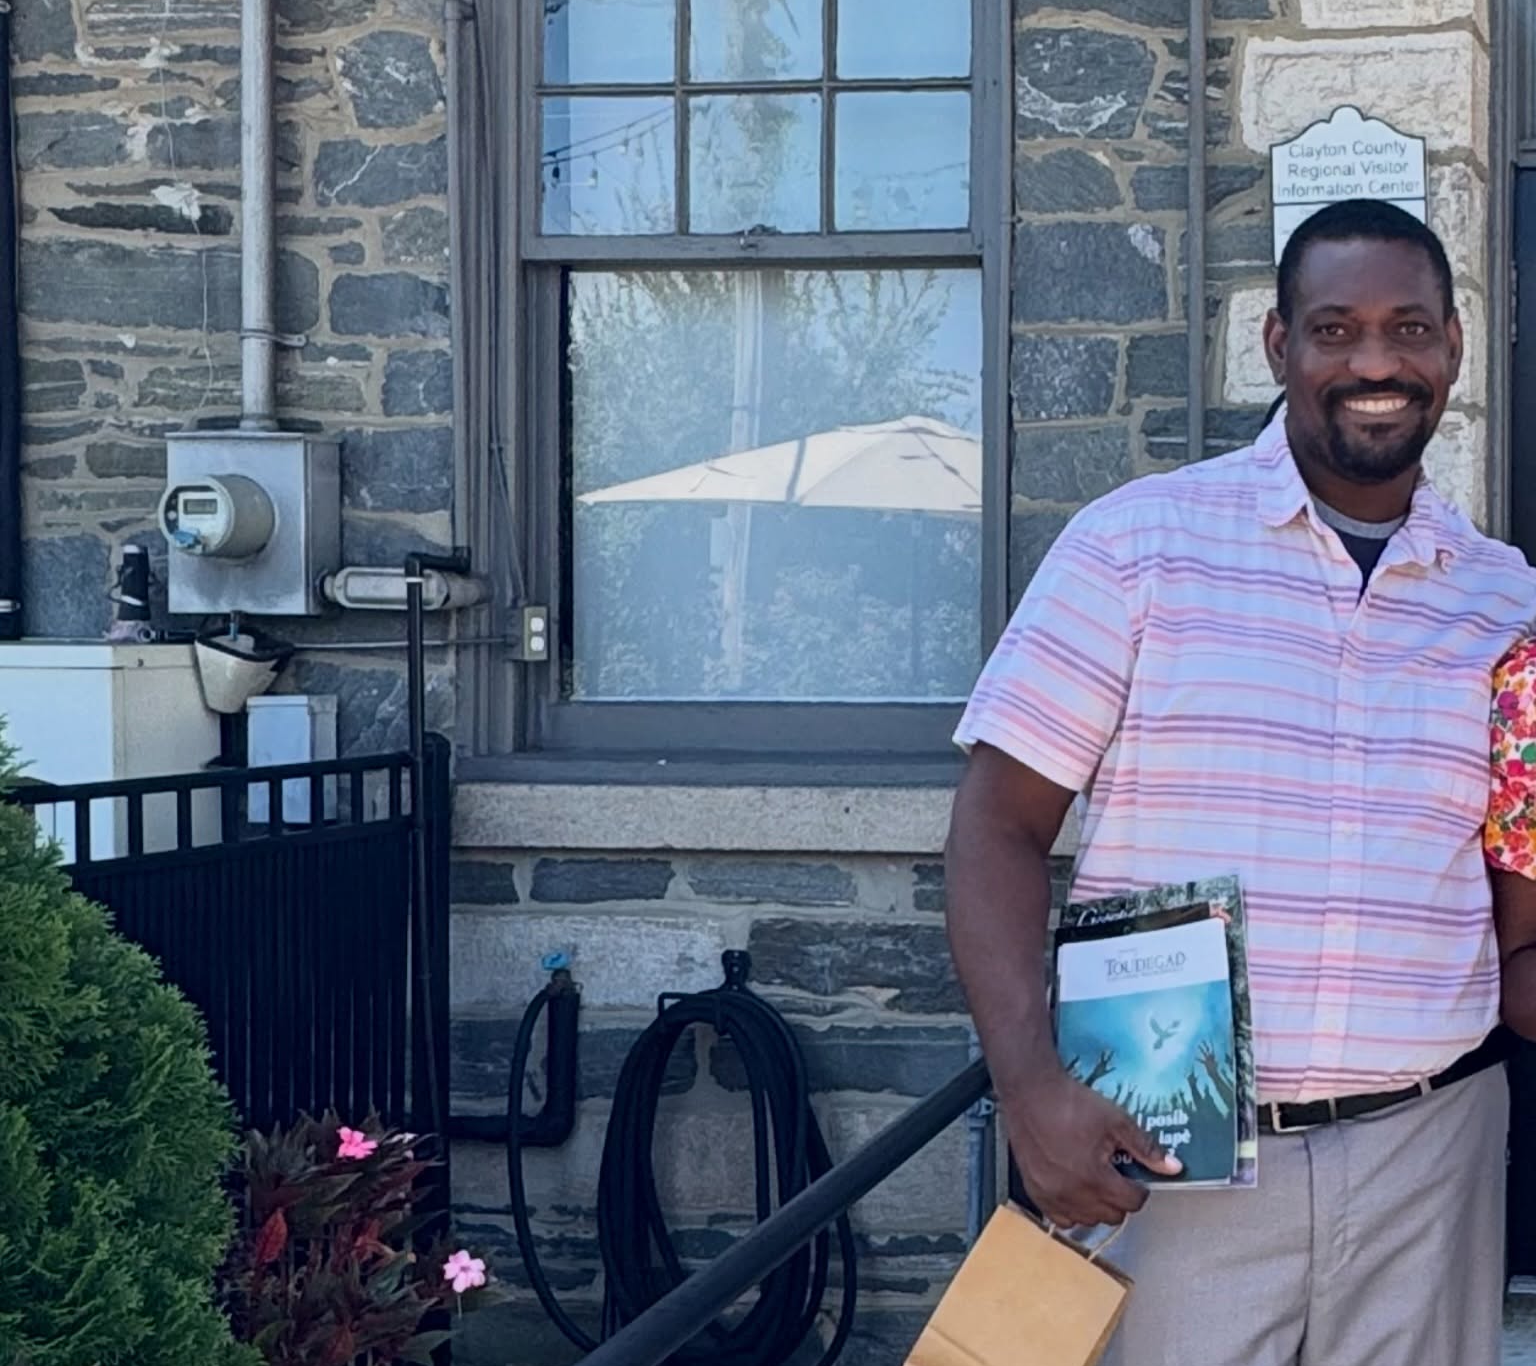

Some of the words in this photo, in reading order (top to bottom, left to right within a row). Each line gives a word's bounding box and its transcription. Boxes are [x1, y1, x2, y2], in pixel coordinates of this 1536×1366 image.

[1288, 143, 1347, 161] Clayton
[1352, 139, 1407, 156] County
[1287, 162, 1355, 181] Regional
[1360, 161, 1409, 176] Visitor
[1277, 182, 1363, 198] Information
[1368, 180, 1420, 195] Center
